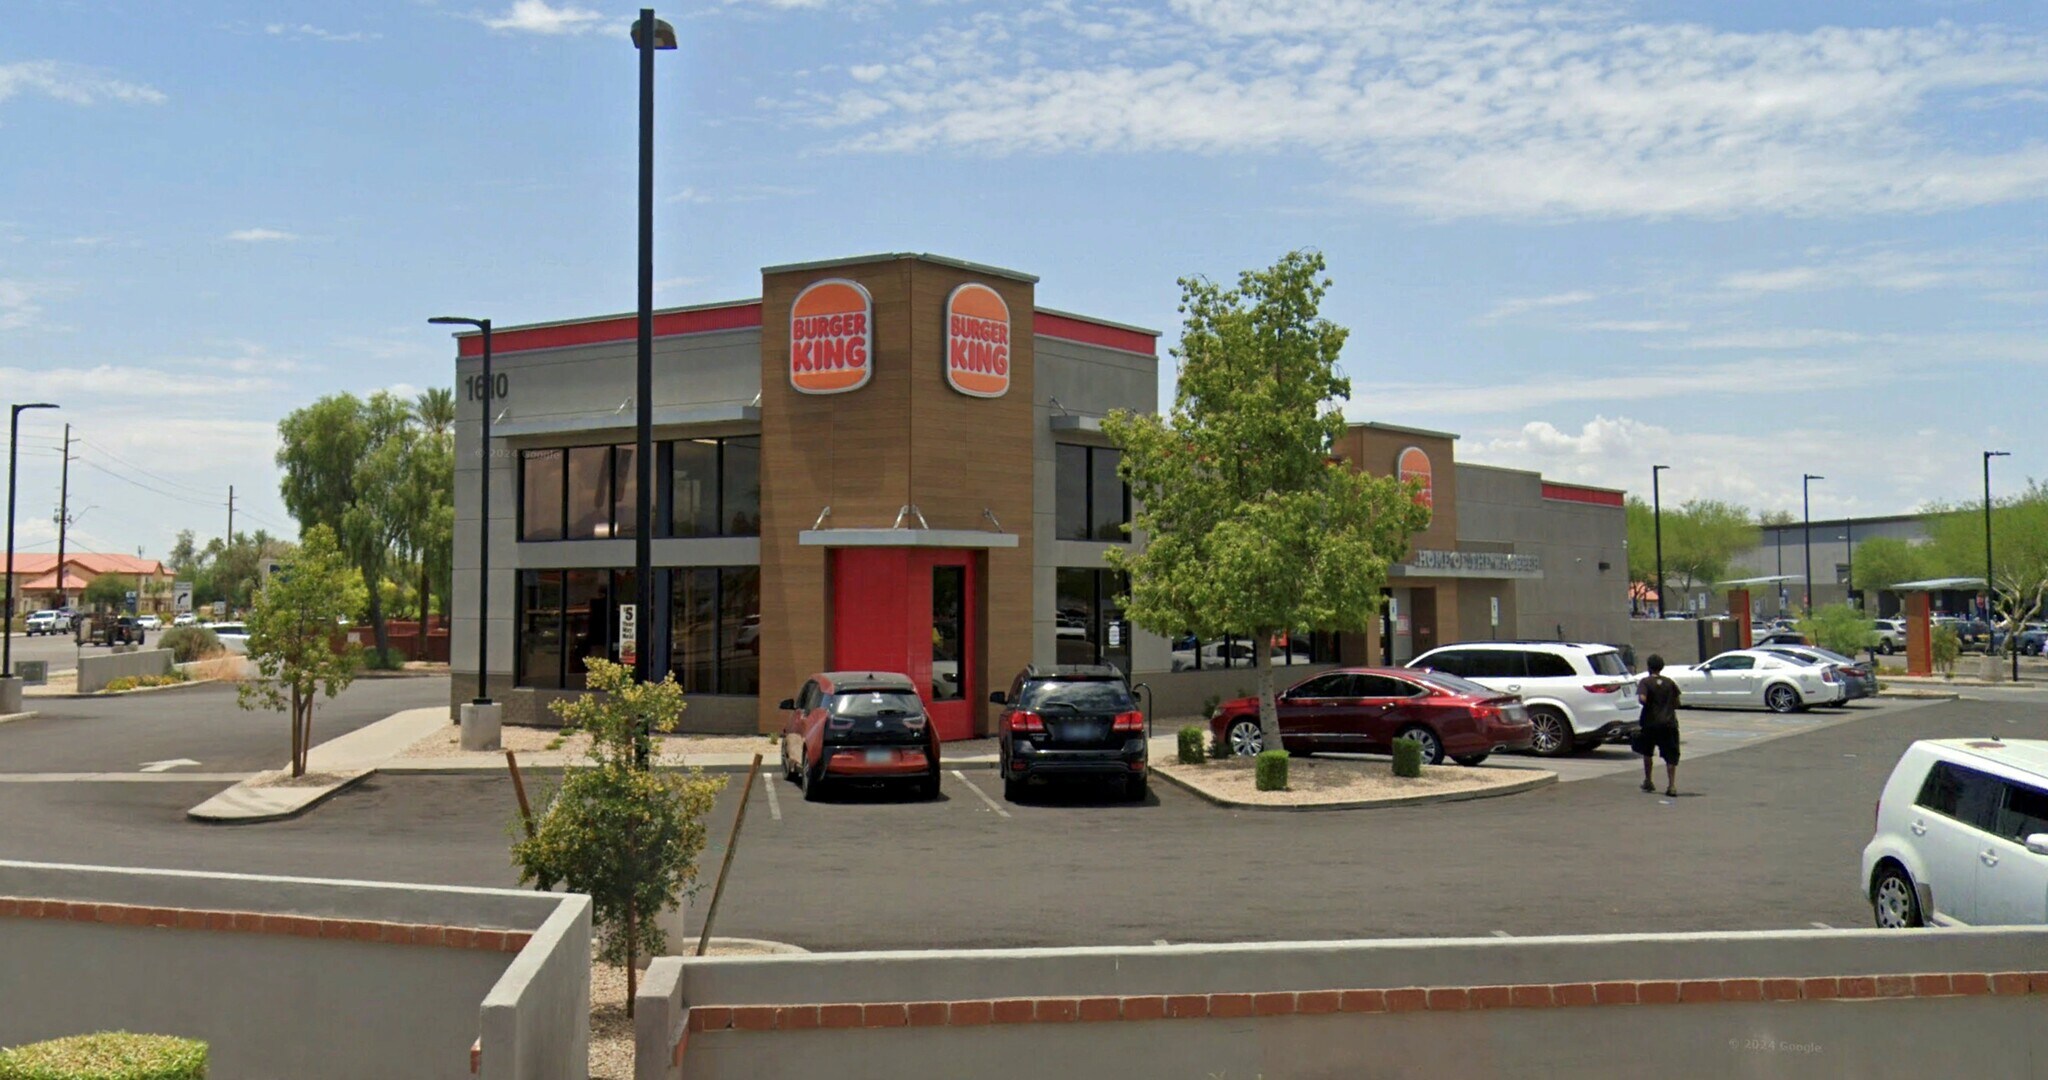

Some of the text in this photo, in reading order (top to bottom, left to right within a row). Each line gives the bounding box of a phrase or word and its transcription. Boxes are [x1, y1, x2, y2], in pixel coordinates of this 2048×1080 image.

[793, 313, 866, 340] BURGER
[951, 316, 1008, 345] BURGER
[793, 336, 866, 372] KING
[951, 337, 1008, 375] KING
[465, 372, 508, 401] 1610
